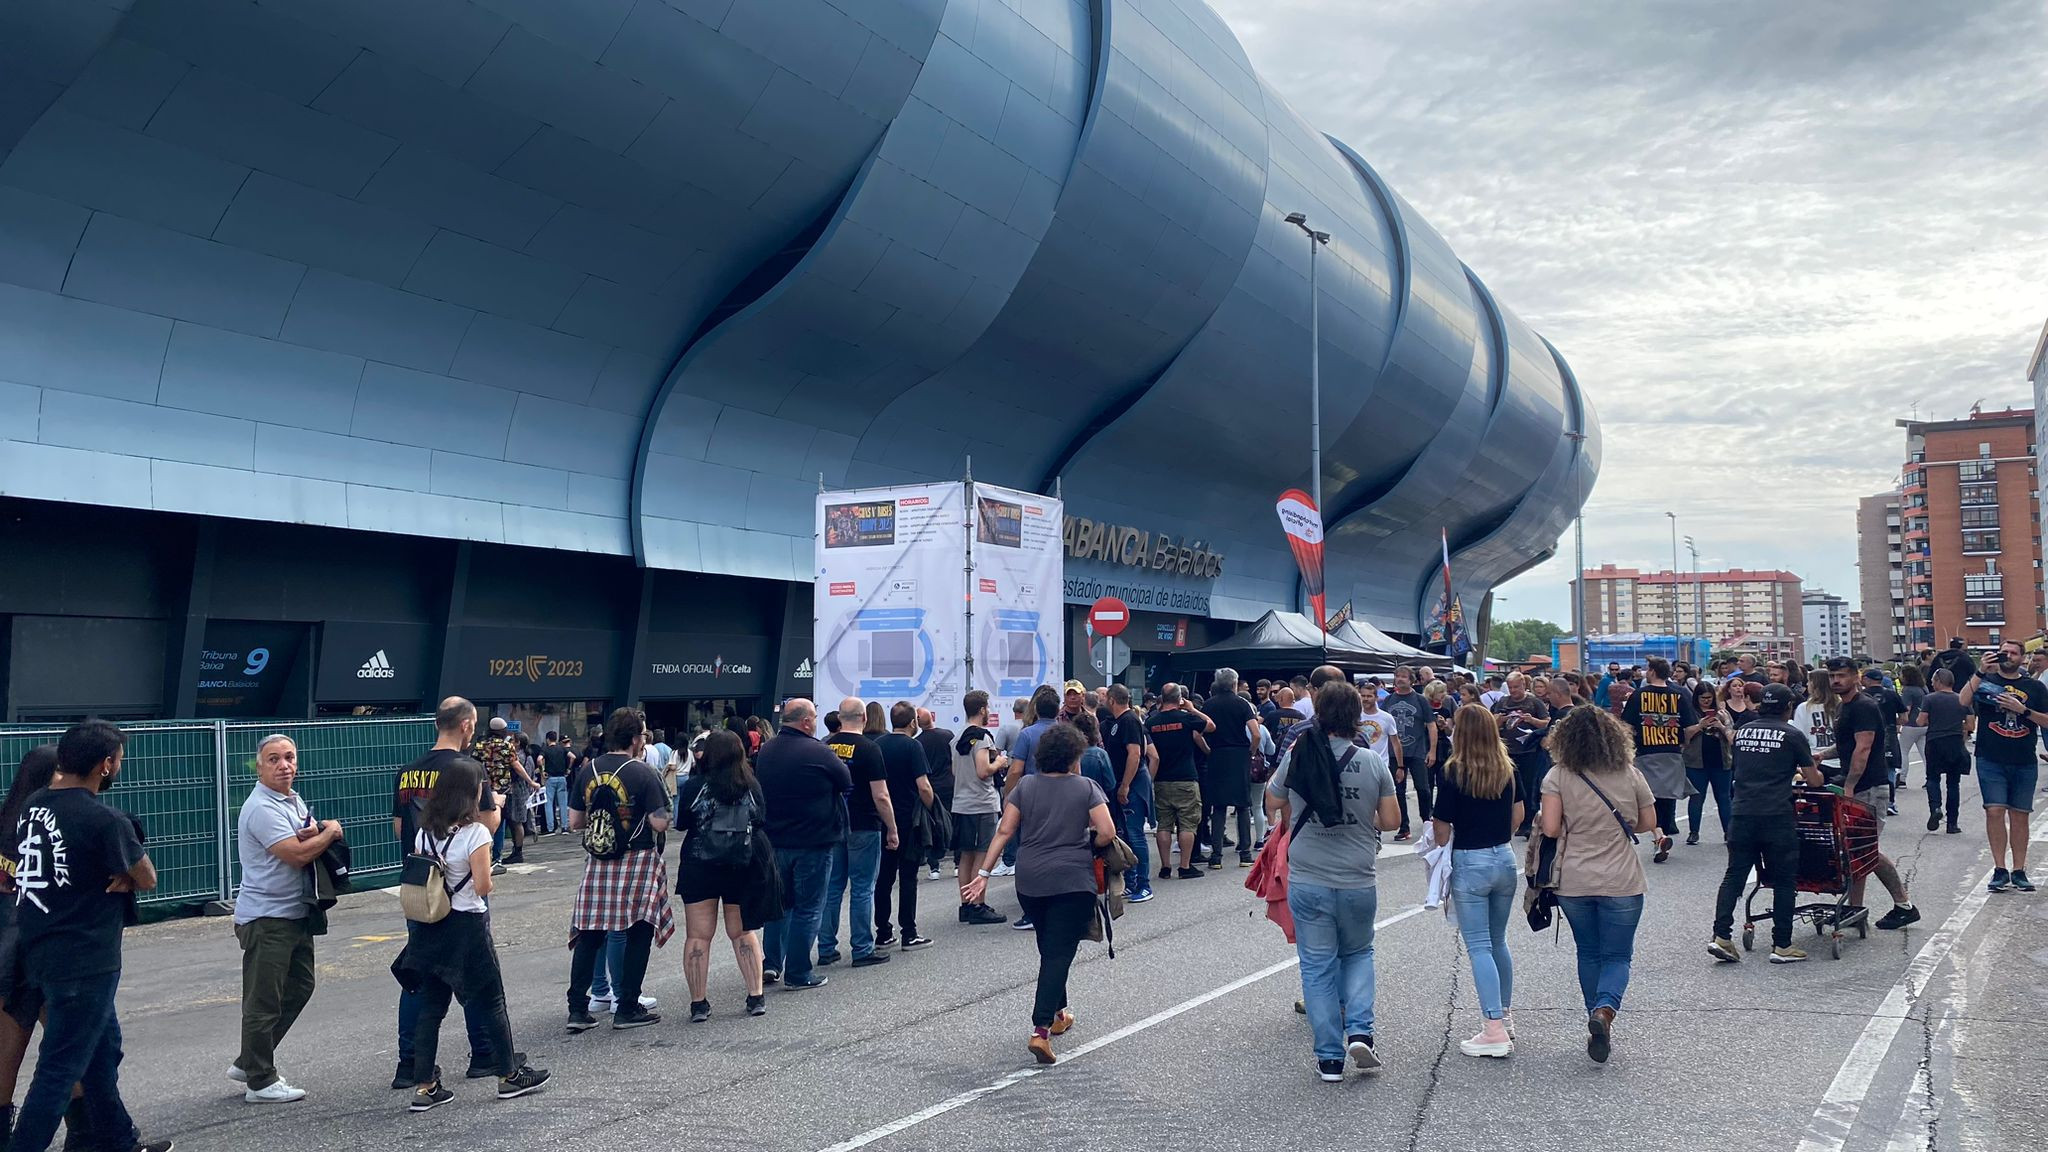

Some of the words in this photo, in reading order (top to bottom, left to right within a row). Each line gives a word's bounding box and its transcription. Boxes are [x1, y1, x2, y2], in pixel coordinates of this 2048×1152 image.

[1063, 515, 1149, 567] ABANCA
[1158, 587, 1168, 607] de
[201, 650, 238, 660] Tribuna
[243, 647, 270, 675] 9
[357, 667, 394, 678] adidas
[489, 659, 523, 676] 1923
[547, 660, 583, 676] 2023
[652, 664, 680, 674] TENDA
[682, 664, 714, 674] OFICIAL
[793, 671, 813, 679] adidas
[1641, 691, 1667, 713] GUNS
[1670, 693, 1681, 714] N'
[1642, 725, 1679, 746] ROSES
[1760, 740, 1781, 749] WARD
[29, 806, 72, 888] TENDENCIES
